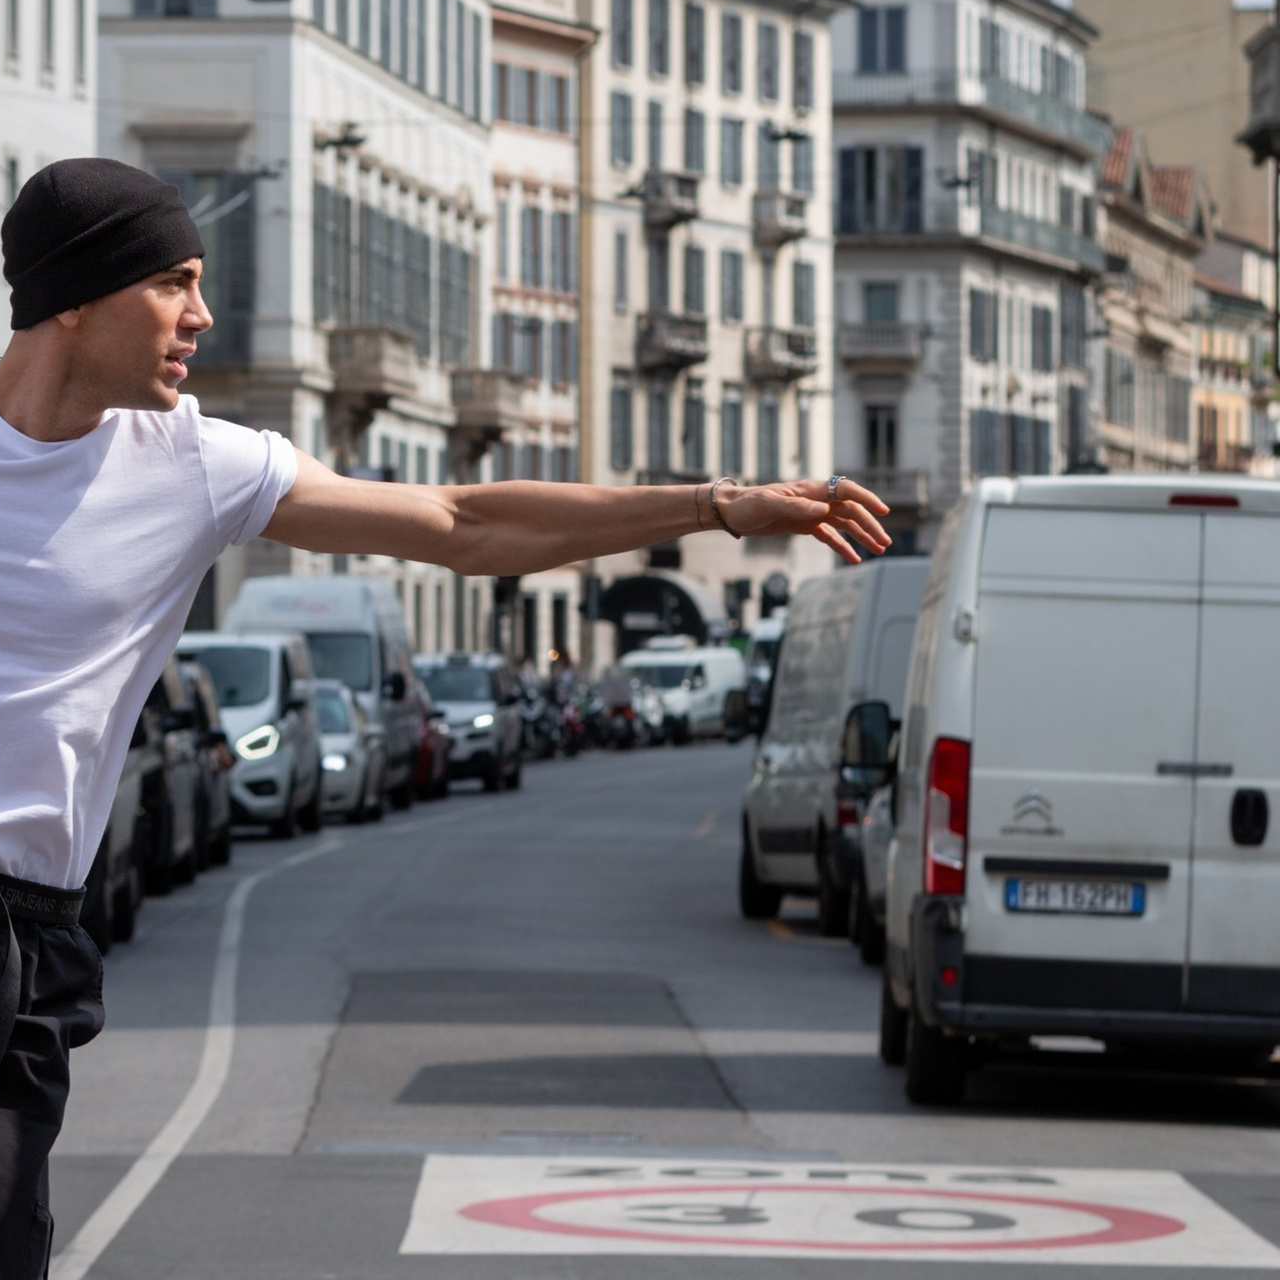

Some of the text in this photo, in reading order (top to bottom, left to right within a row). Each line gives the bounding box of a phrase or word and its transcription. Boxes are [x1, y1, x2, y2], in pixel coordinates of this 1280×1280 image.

[22, 893, 57, 914] JEANS
[543, 1165, 1060, 1185] zona
[623, 1204, 1018, 1231] 30
